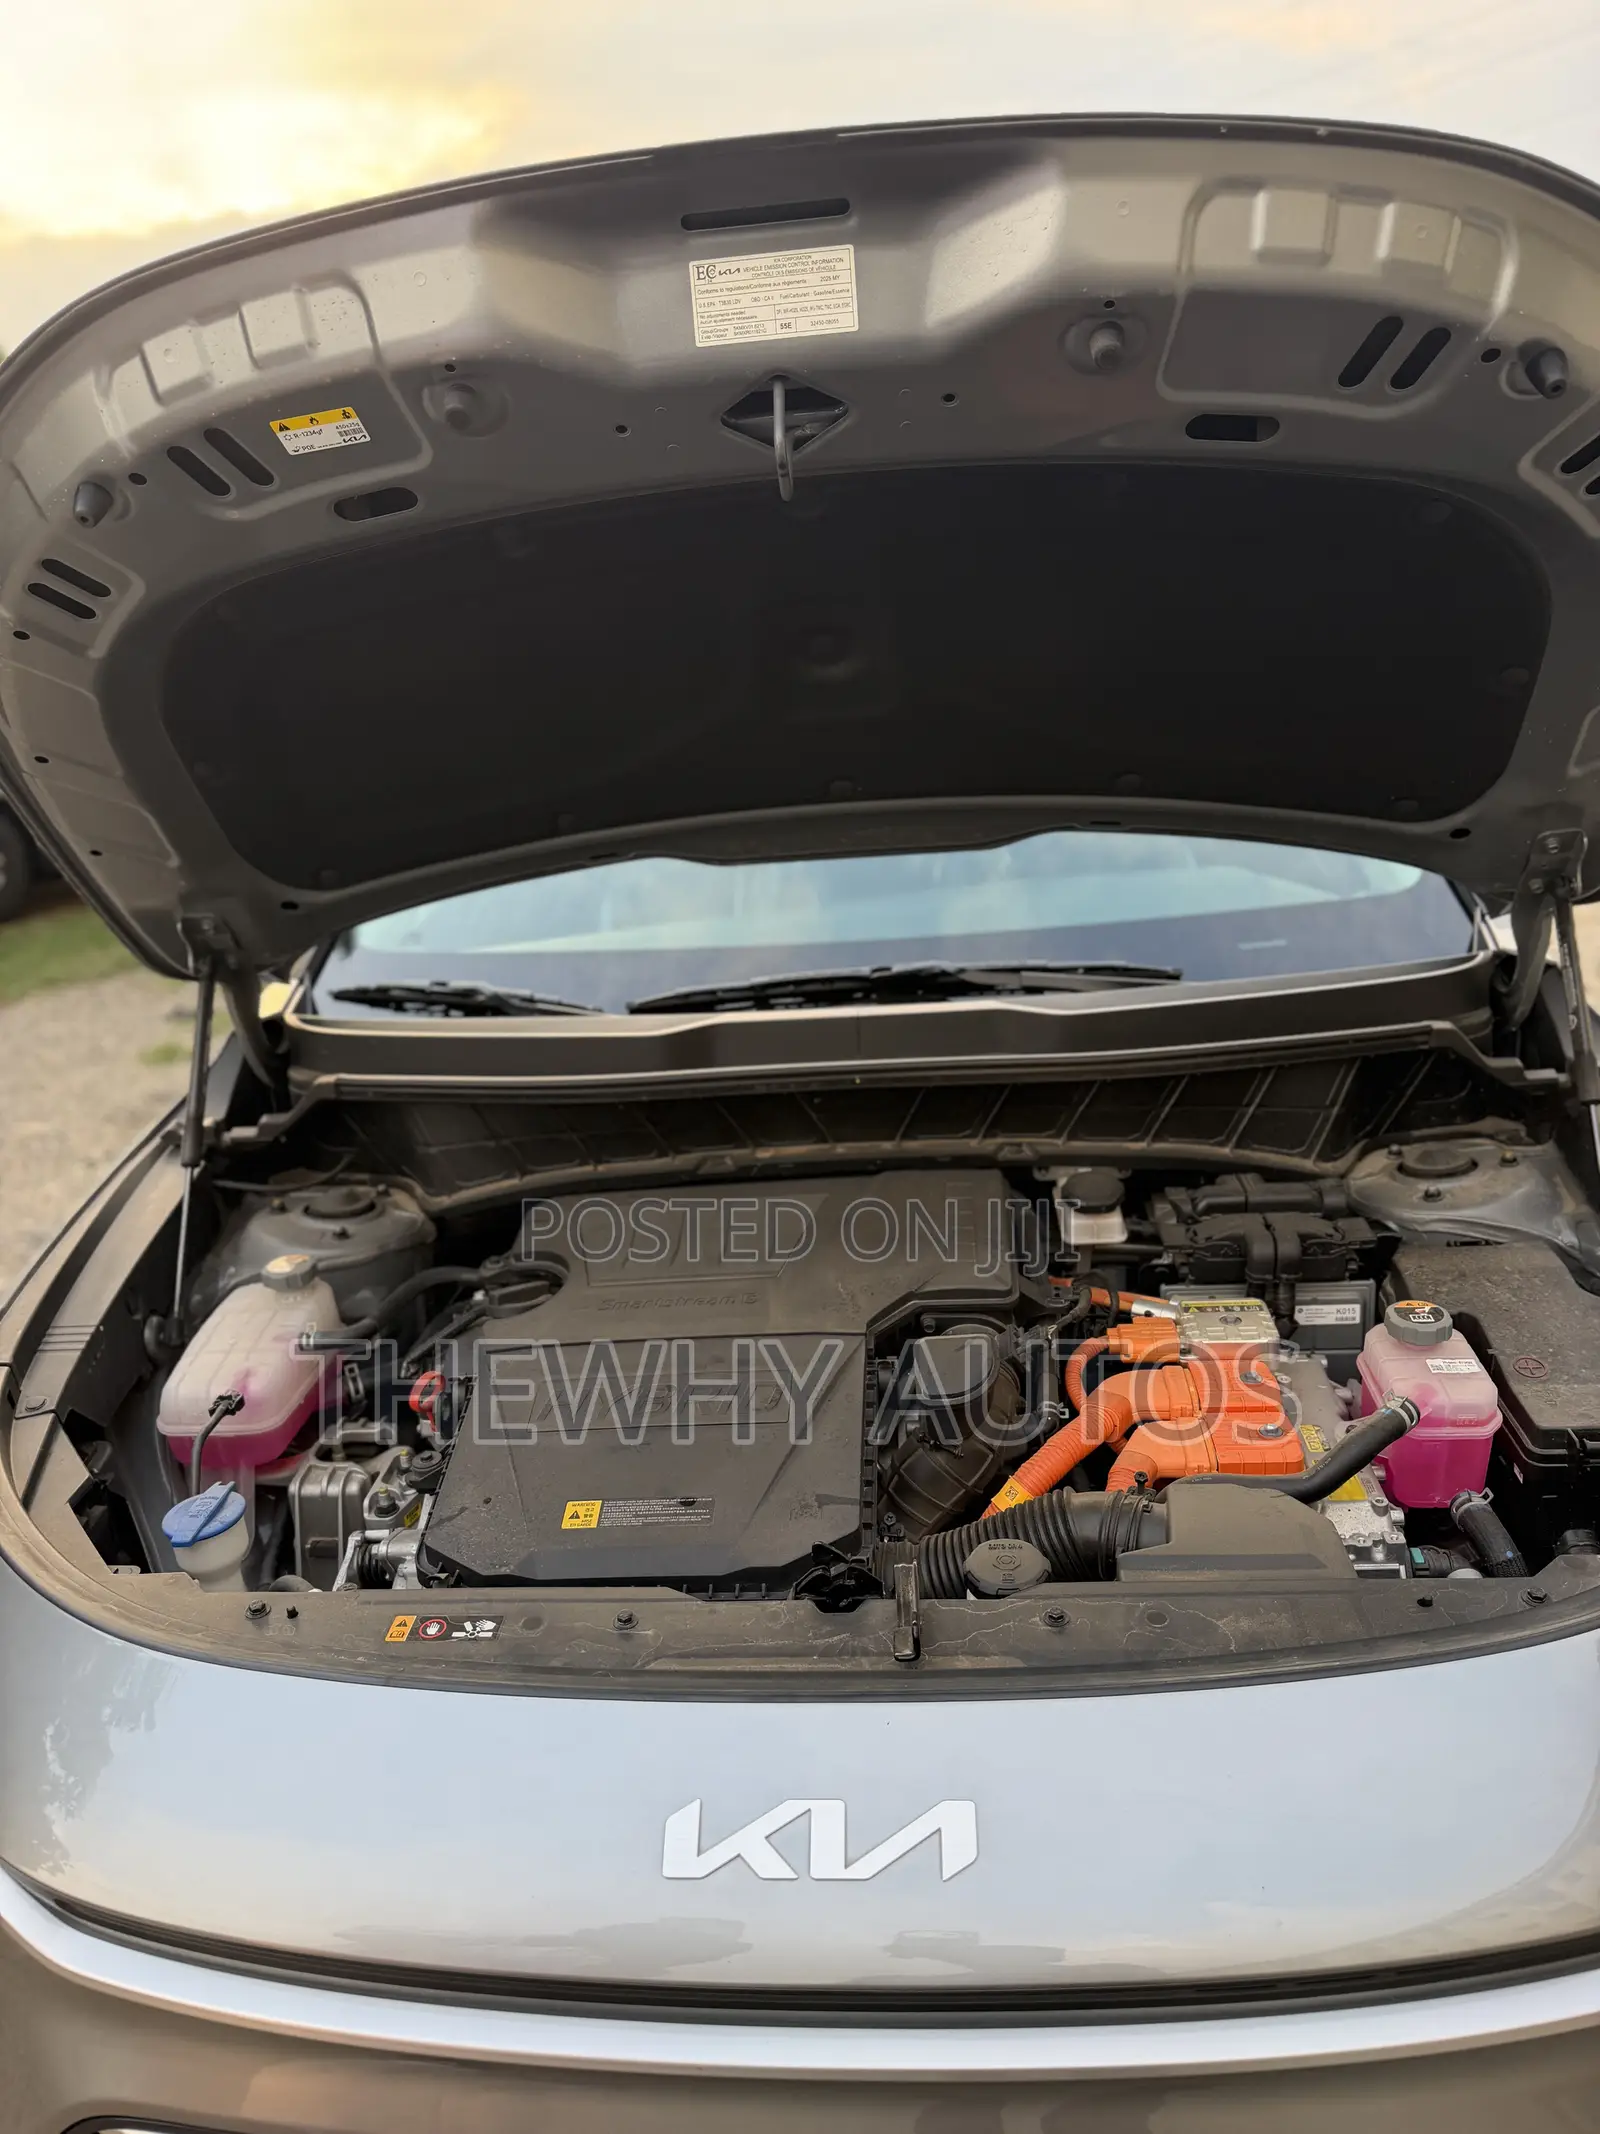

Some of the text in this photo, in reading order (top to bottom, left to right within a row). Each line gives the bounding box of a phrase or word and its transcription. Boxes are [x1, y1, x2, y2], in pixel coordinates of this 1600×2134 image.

[781, 254, 812, 262] CORPORATION
[764, 263, 787, 271] EMISSION
[811, 257, 844, 266] INFORMATION
[718, 268, 741, 276] KIA
[813, 287, 850, 296] Gasoline/Essence
[780, 322, 792, 330] 55E
[700, 327, 729, 335] Group/Groupe
[342, 435, 367, 443] KIA
[598, 1296, 735, 1311] Smartstream
[536, 1384, 785, 1421] HYBRID
[662, 1798, 979, 1881] KIA
